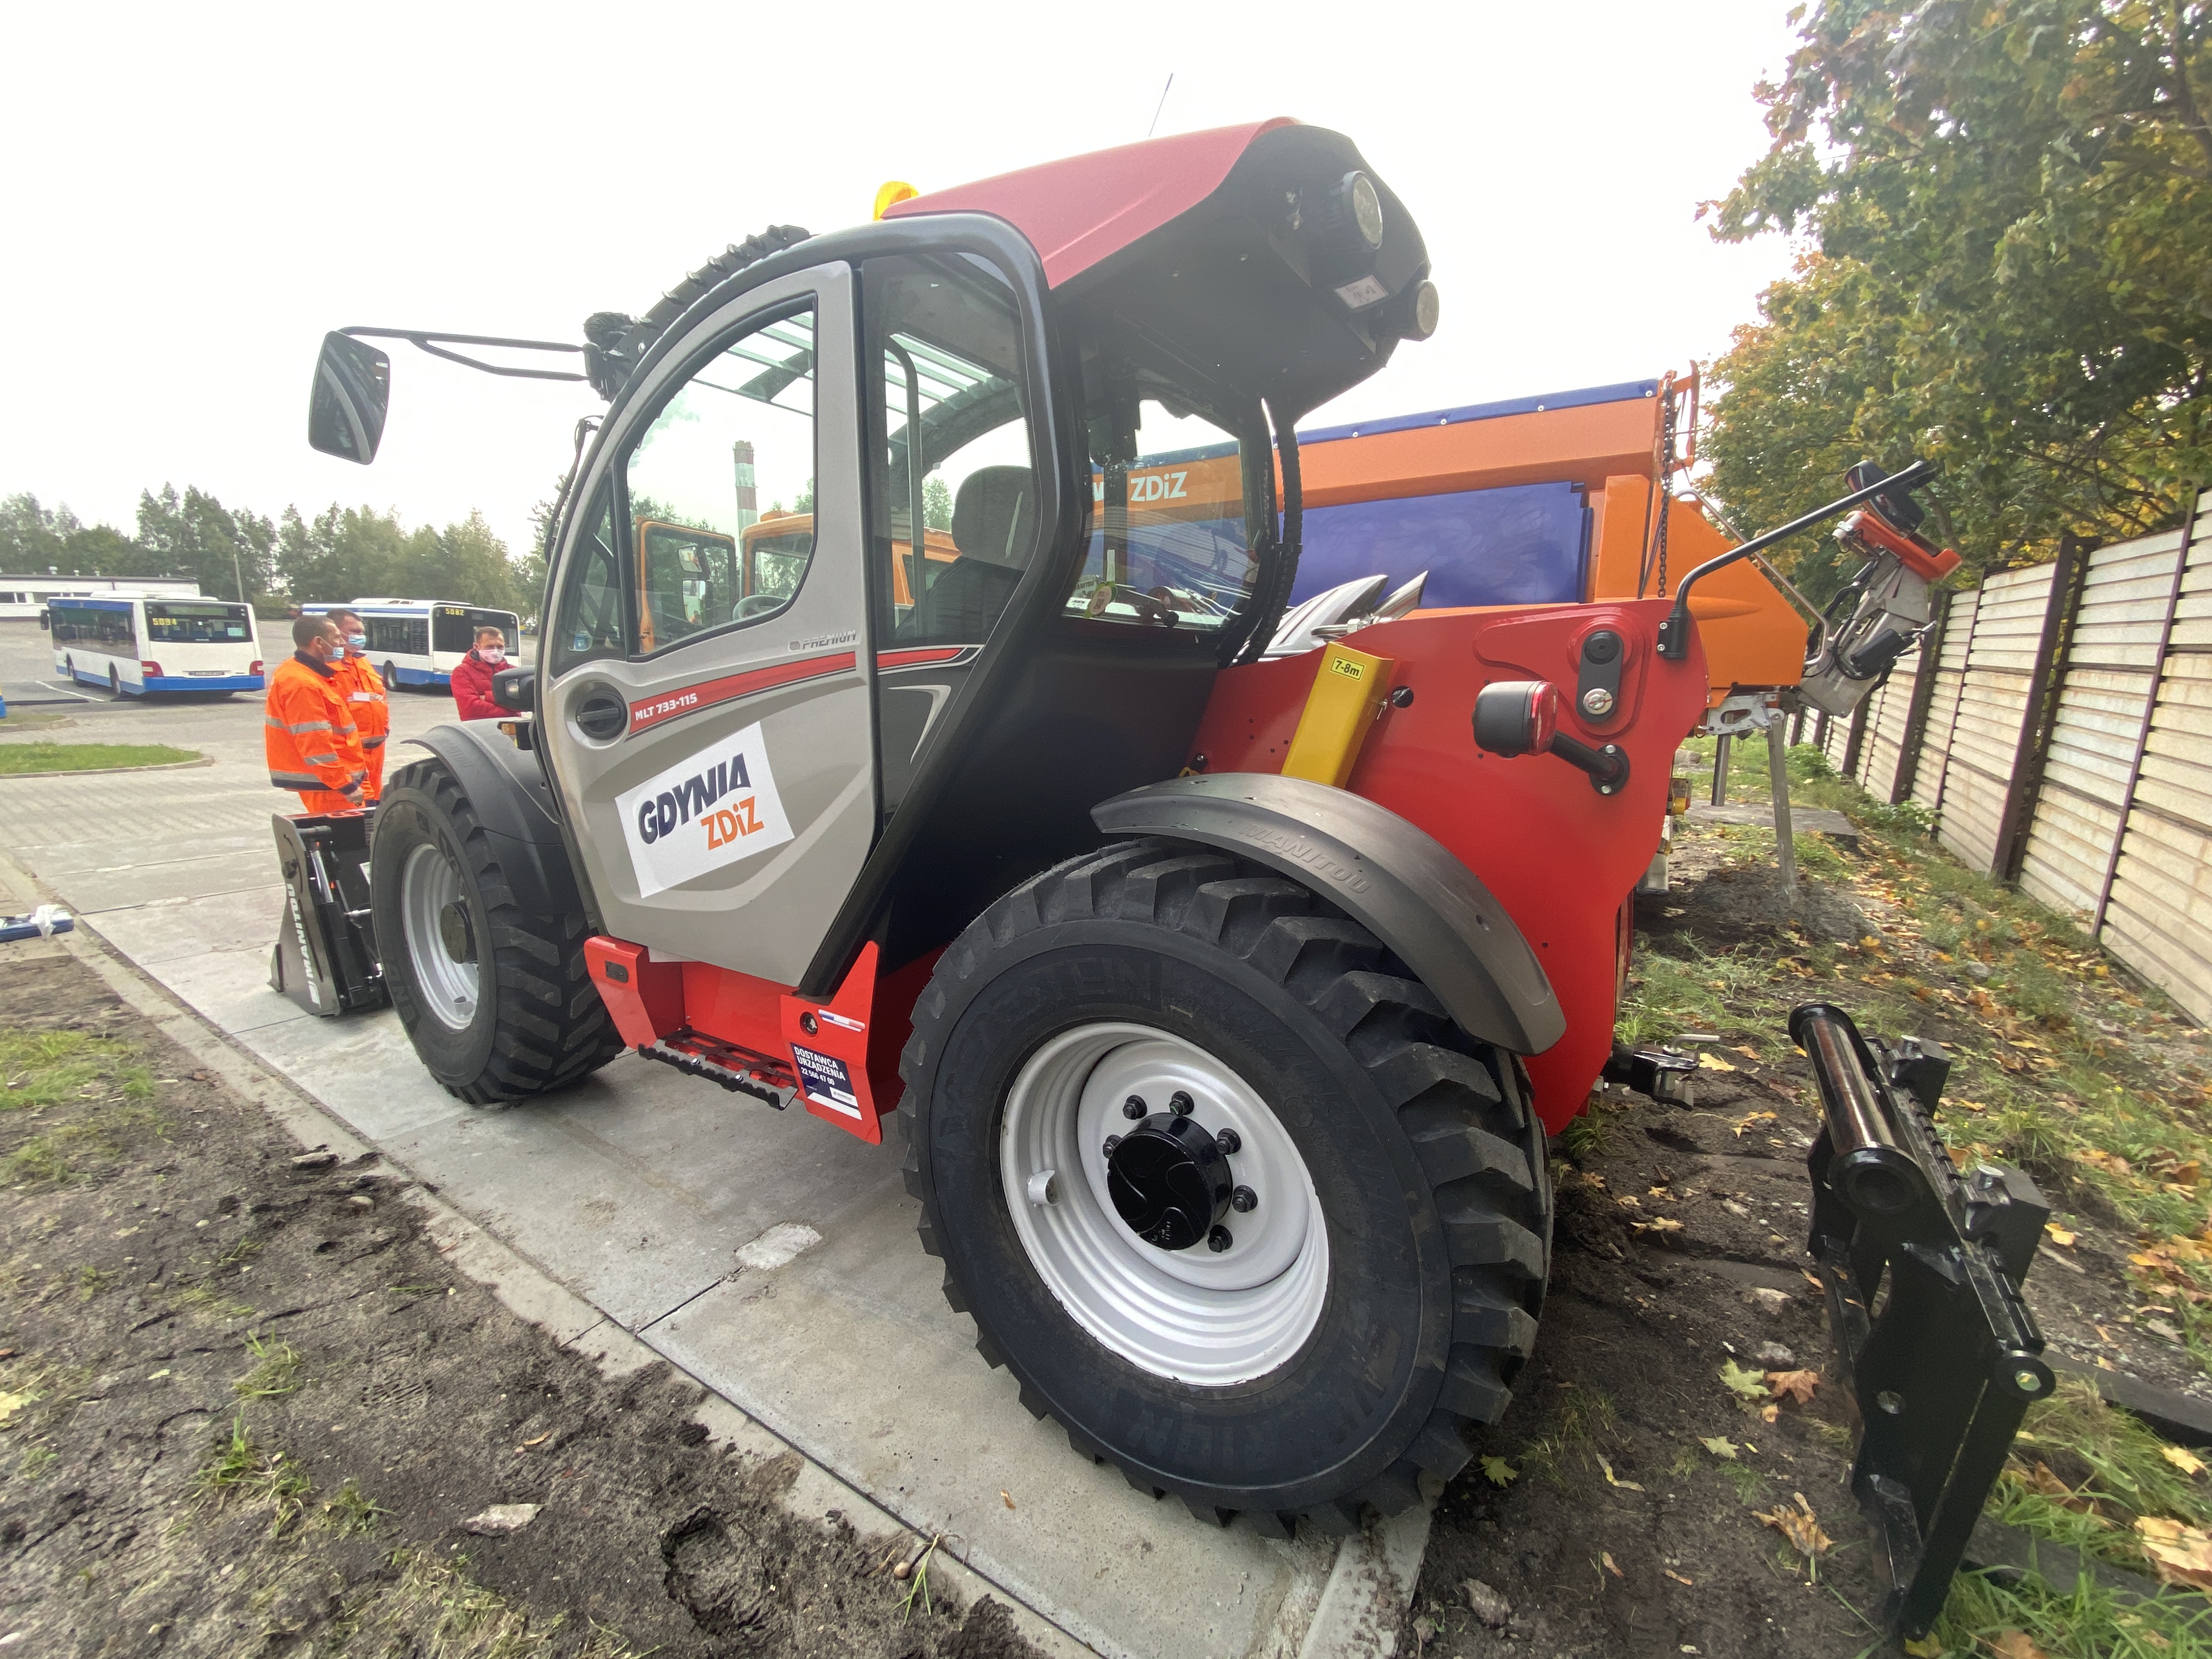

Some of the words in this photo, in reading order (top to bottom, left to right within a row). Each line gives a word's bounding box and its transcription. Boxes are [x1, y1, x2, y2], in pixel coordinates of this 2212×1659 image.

[1130, 471, 1188, 501] ZDiZ
[802, 629, 857, 650] PREMIUM
[1334, 659, 1361, 677] 7-8m
[635, 706, 654, 721] MLT
[656, 693, 698, 715] 733-115
[638, 752, 752, 845] GDYNIA
[700, 795, 765, 851] ZDiZ
[1239, 823, 1373, 894] MANITOU
[286, 883, 314, 979] MANITOU
[794, 1046, 839, 1070] DOSTAWCA
[797, 1056, 846, 1081] URZĄDZENIA
[801, 1067, 809, 1076] 22
